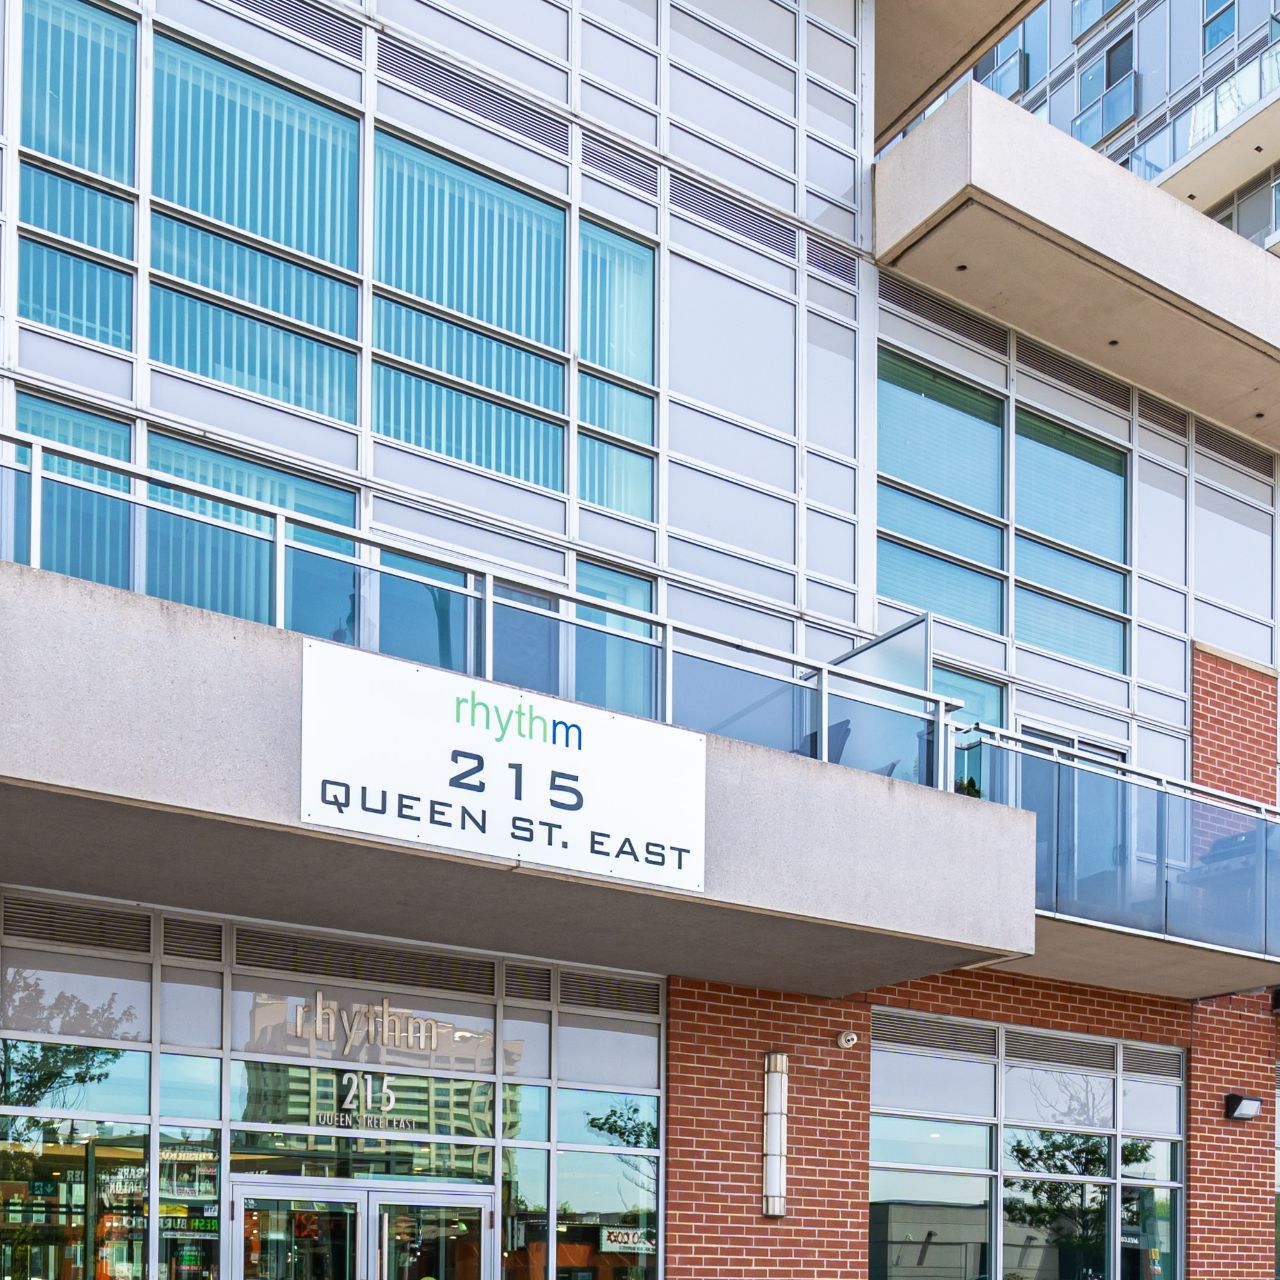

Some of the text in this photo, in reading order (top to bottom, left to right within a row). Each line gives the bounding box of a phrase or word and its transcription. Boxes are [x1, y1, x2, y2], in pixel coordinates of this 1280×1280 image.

[454, 690, 583, 751] rhythm
[448, 749, 585, 812] 215
[320, 778, 692, 871] QUEEN ST. EAST
[294, 990, 438, 1056] rhythm
[318, 1112, 417, 1131] QUEEN STREET EAST
[341, 1072, 396, 1112] 215
